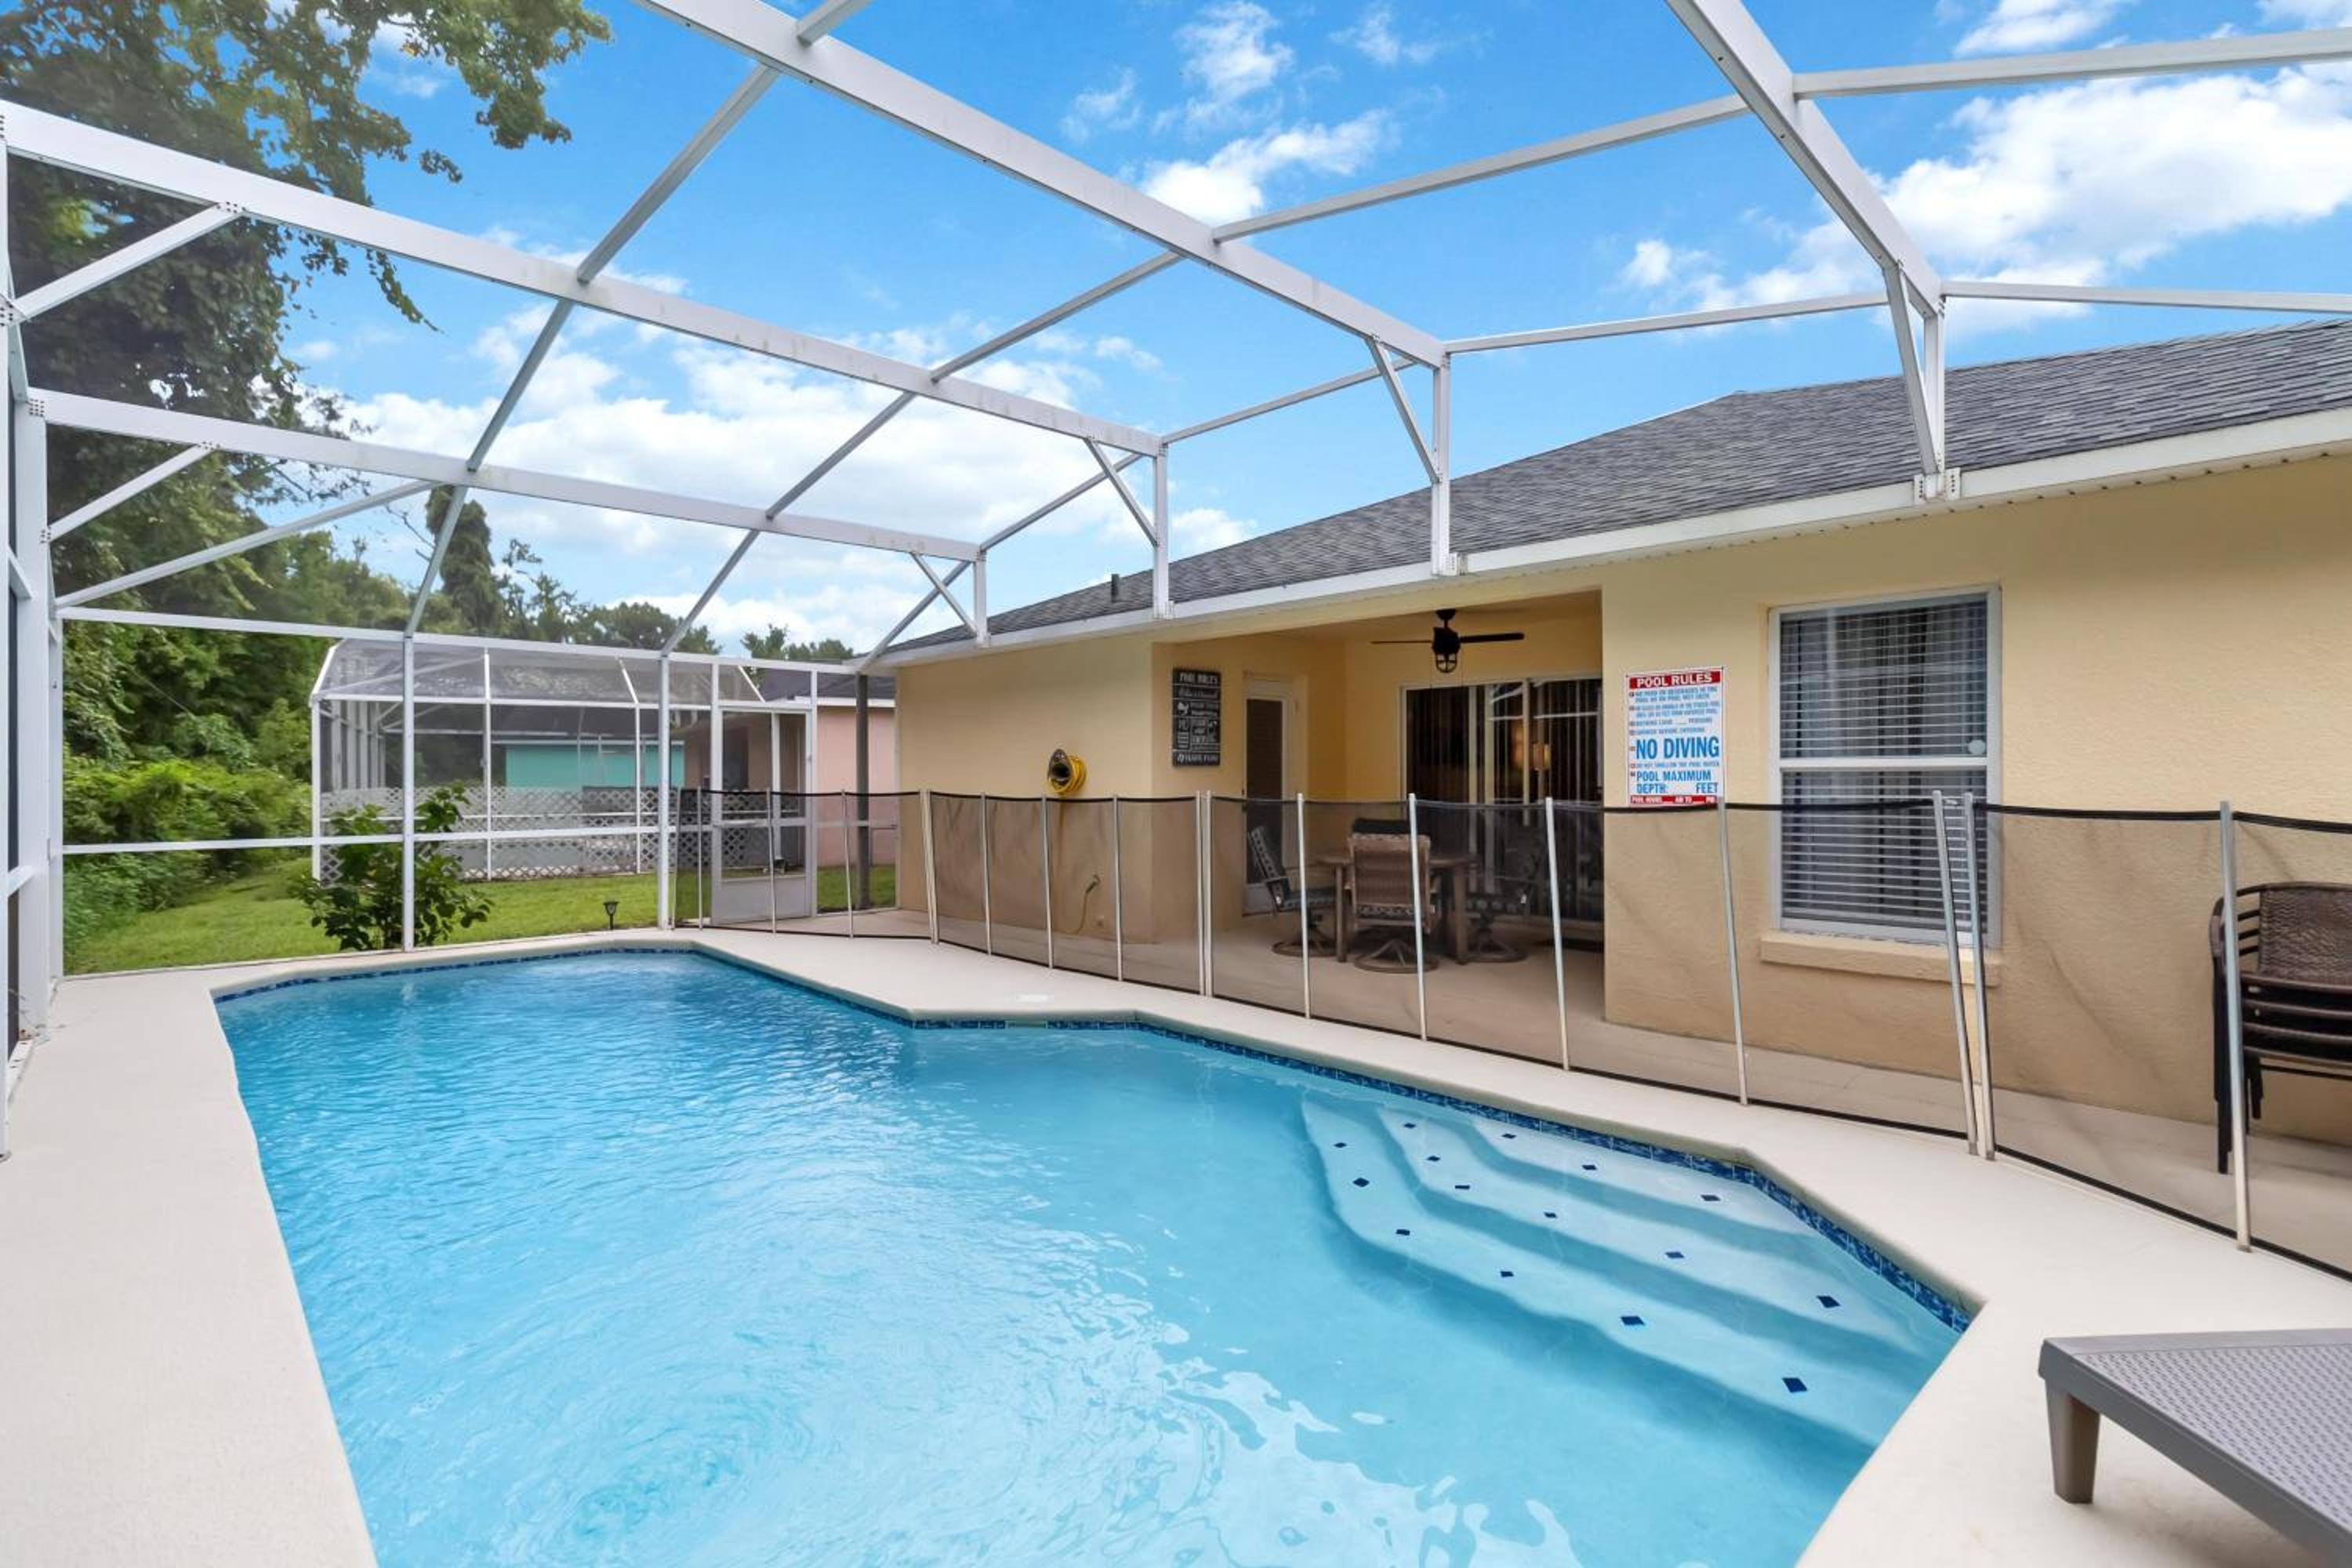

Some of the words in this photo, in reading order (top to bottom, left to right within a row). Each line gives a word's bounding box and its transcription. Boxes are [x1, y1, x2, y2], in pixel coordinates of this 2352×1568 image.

[1637, 676, 1668, 688] POOL
[1672, 673, 1712, 685] RULES
[1636, 739, 1657, 759] NO
[1664, 736, 1719, 758] DIVING
[1636, 771, 1659, 782] POOL
[1663, 770, 1711, 782] MAXIMUM
[1696, 782, 1719, 793] FEET
